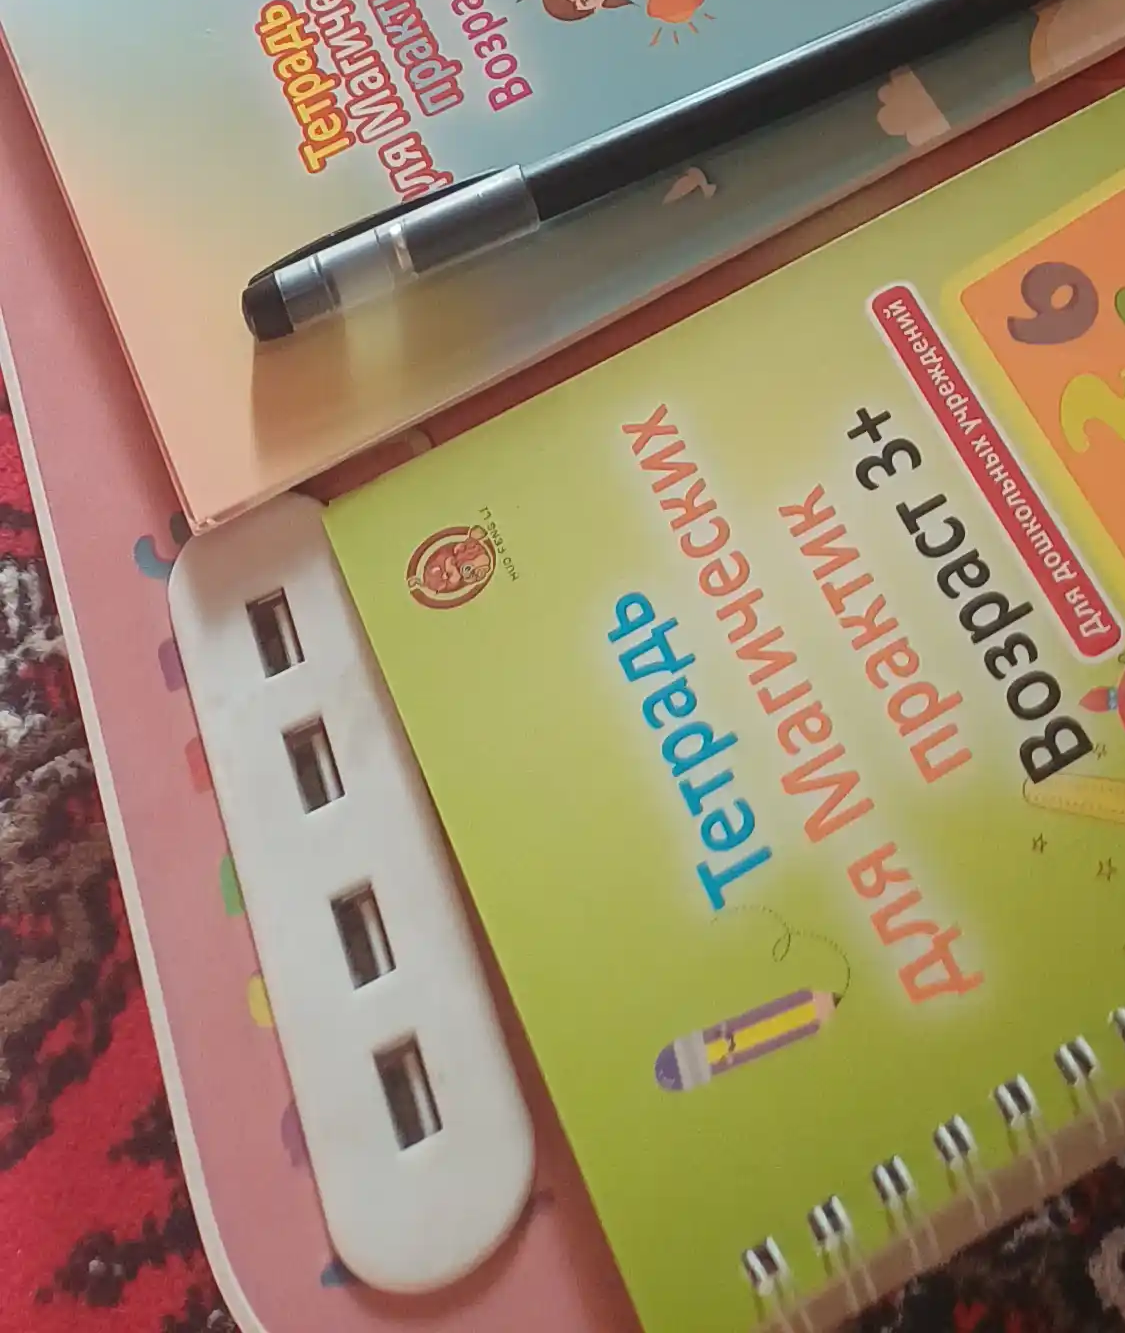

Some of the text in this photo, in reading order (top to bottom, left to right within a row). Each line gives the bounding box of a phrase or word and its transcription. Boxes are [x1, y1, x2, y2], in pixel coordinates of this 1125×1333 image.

[256, 0, 354, 172] Тетрадь
[779, 483, 974, 785] практик
[847, 406, 1094, 785] Возраст 3+
[884, 298, 1114, 640] Для дошкольных учреждений
[607, 590, 772, 911] Тетрадь
[621, 404, 984, 1005] для Магических
